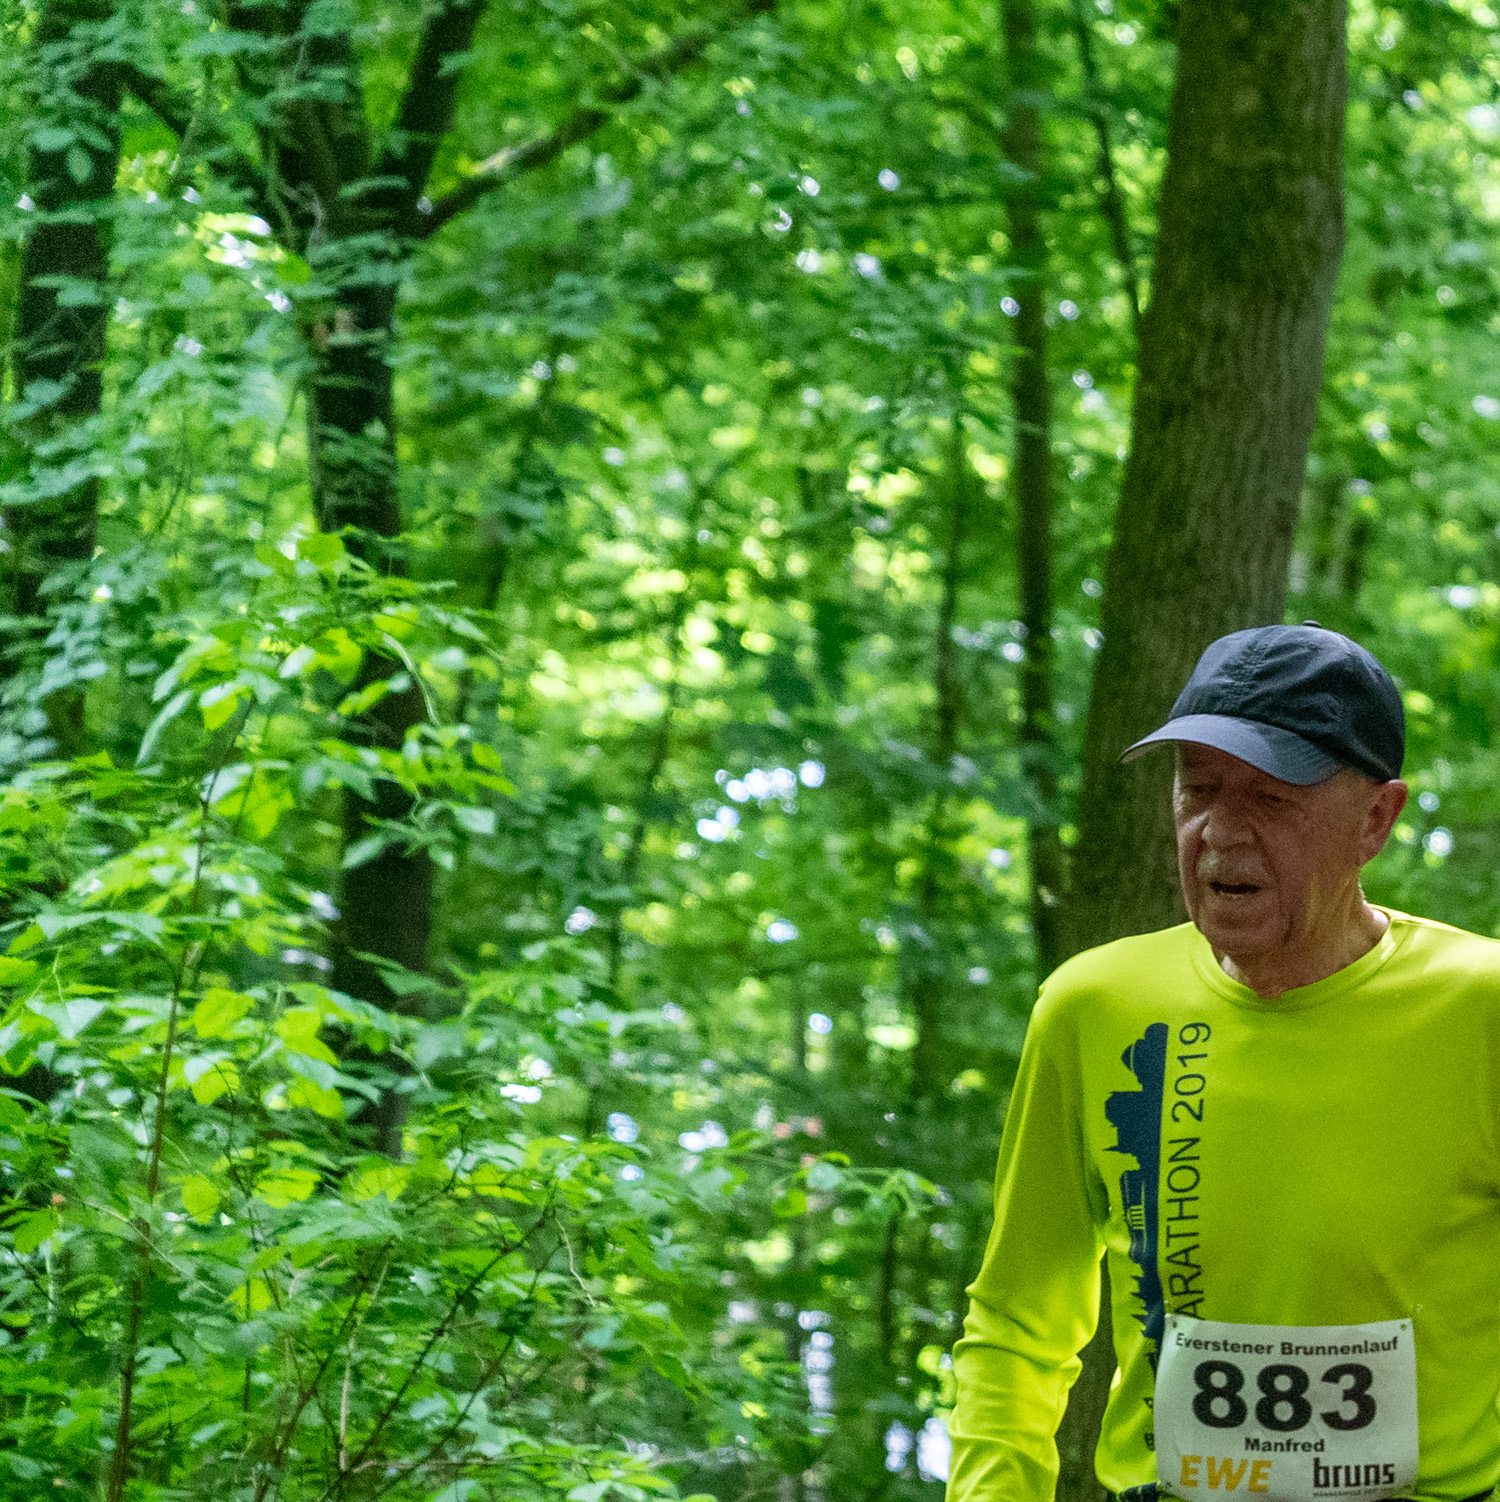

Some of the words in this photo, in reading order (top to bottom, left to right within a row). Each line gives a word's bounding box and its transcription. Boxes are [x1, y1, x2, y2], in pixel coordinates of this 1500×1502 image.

[1171, 1021, 1212, 1123] 2019
[1165, 1136, 1206, 1321] ARATHON
[1176, 1332, 1274, 1355] Everstener
[1280, 1336, 1399, 1356] Brunnenlauf
[1192, 1359, 1378, 1432] 883
[1244, 1436, 1326, 1453] Manfred
[1180, 1454, 1273, 1493] EWE
[1312, 1456, 1396, 1489] bruns
